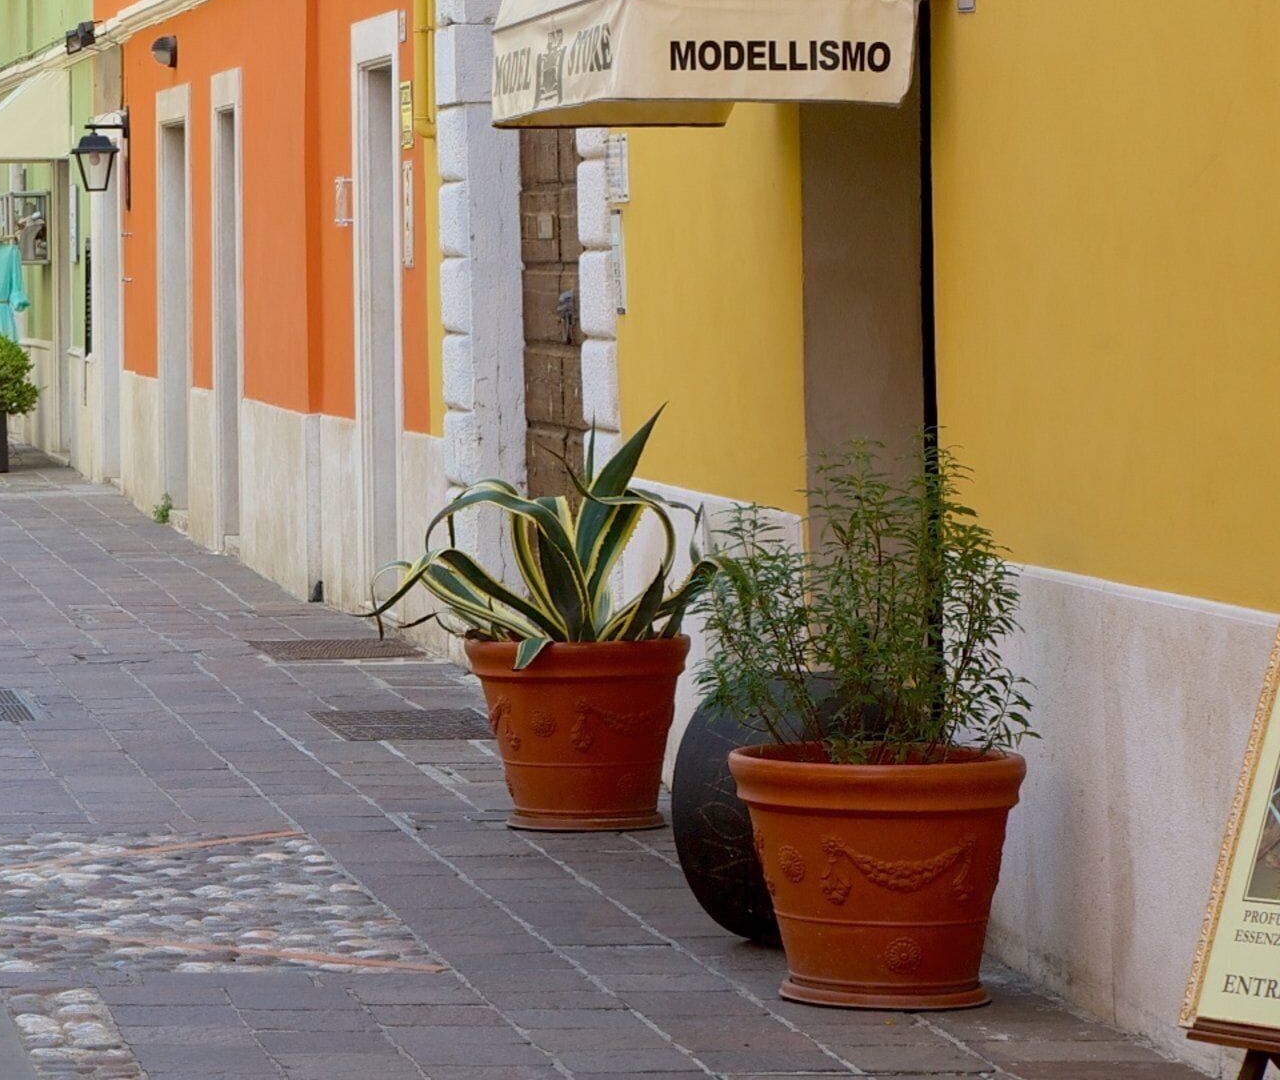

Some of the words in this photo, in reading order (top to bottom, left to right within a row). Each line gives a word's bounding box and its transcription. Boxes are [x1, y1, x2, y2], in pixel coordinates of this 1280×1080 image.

[493, 47, 532, 97] MODEL
[567, 23, 613, 76] STORE
[670, 40, 892, 73] MODELLISMO
[1233, 928, 1280, 946] ESSENZ
[1221, 973, 1280, 1000] ENTR
